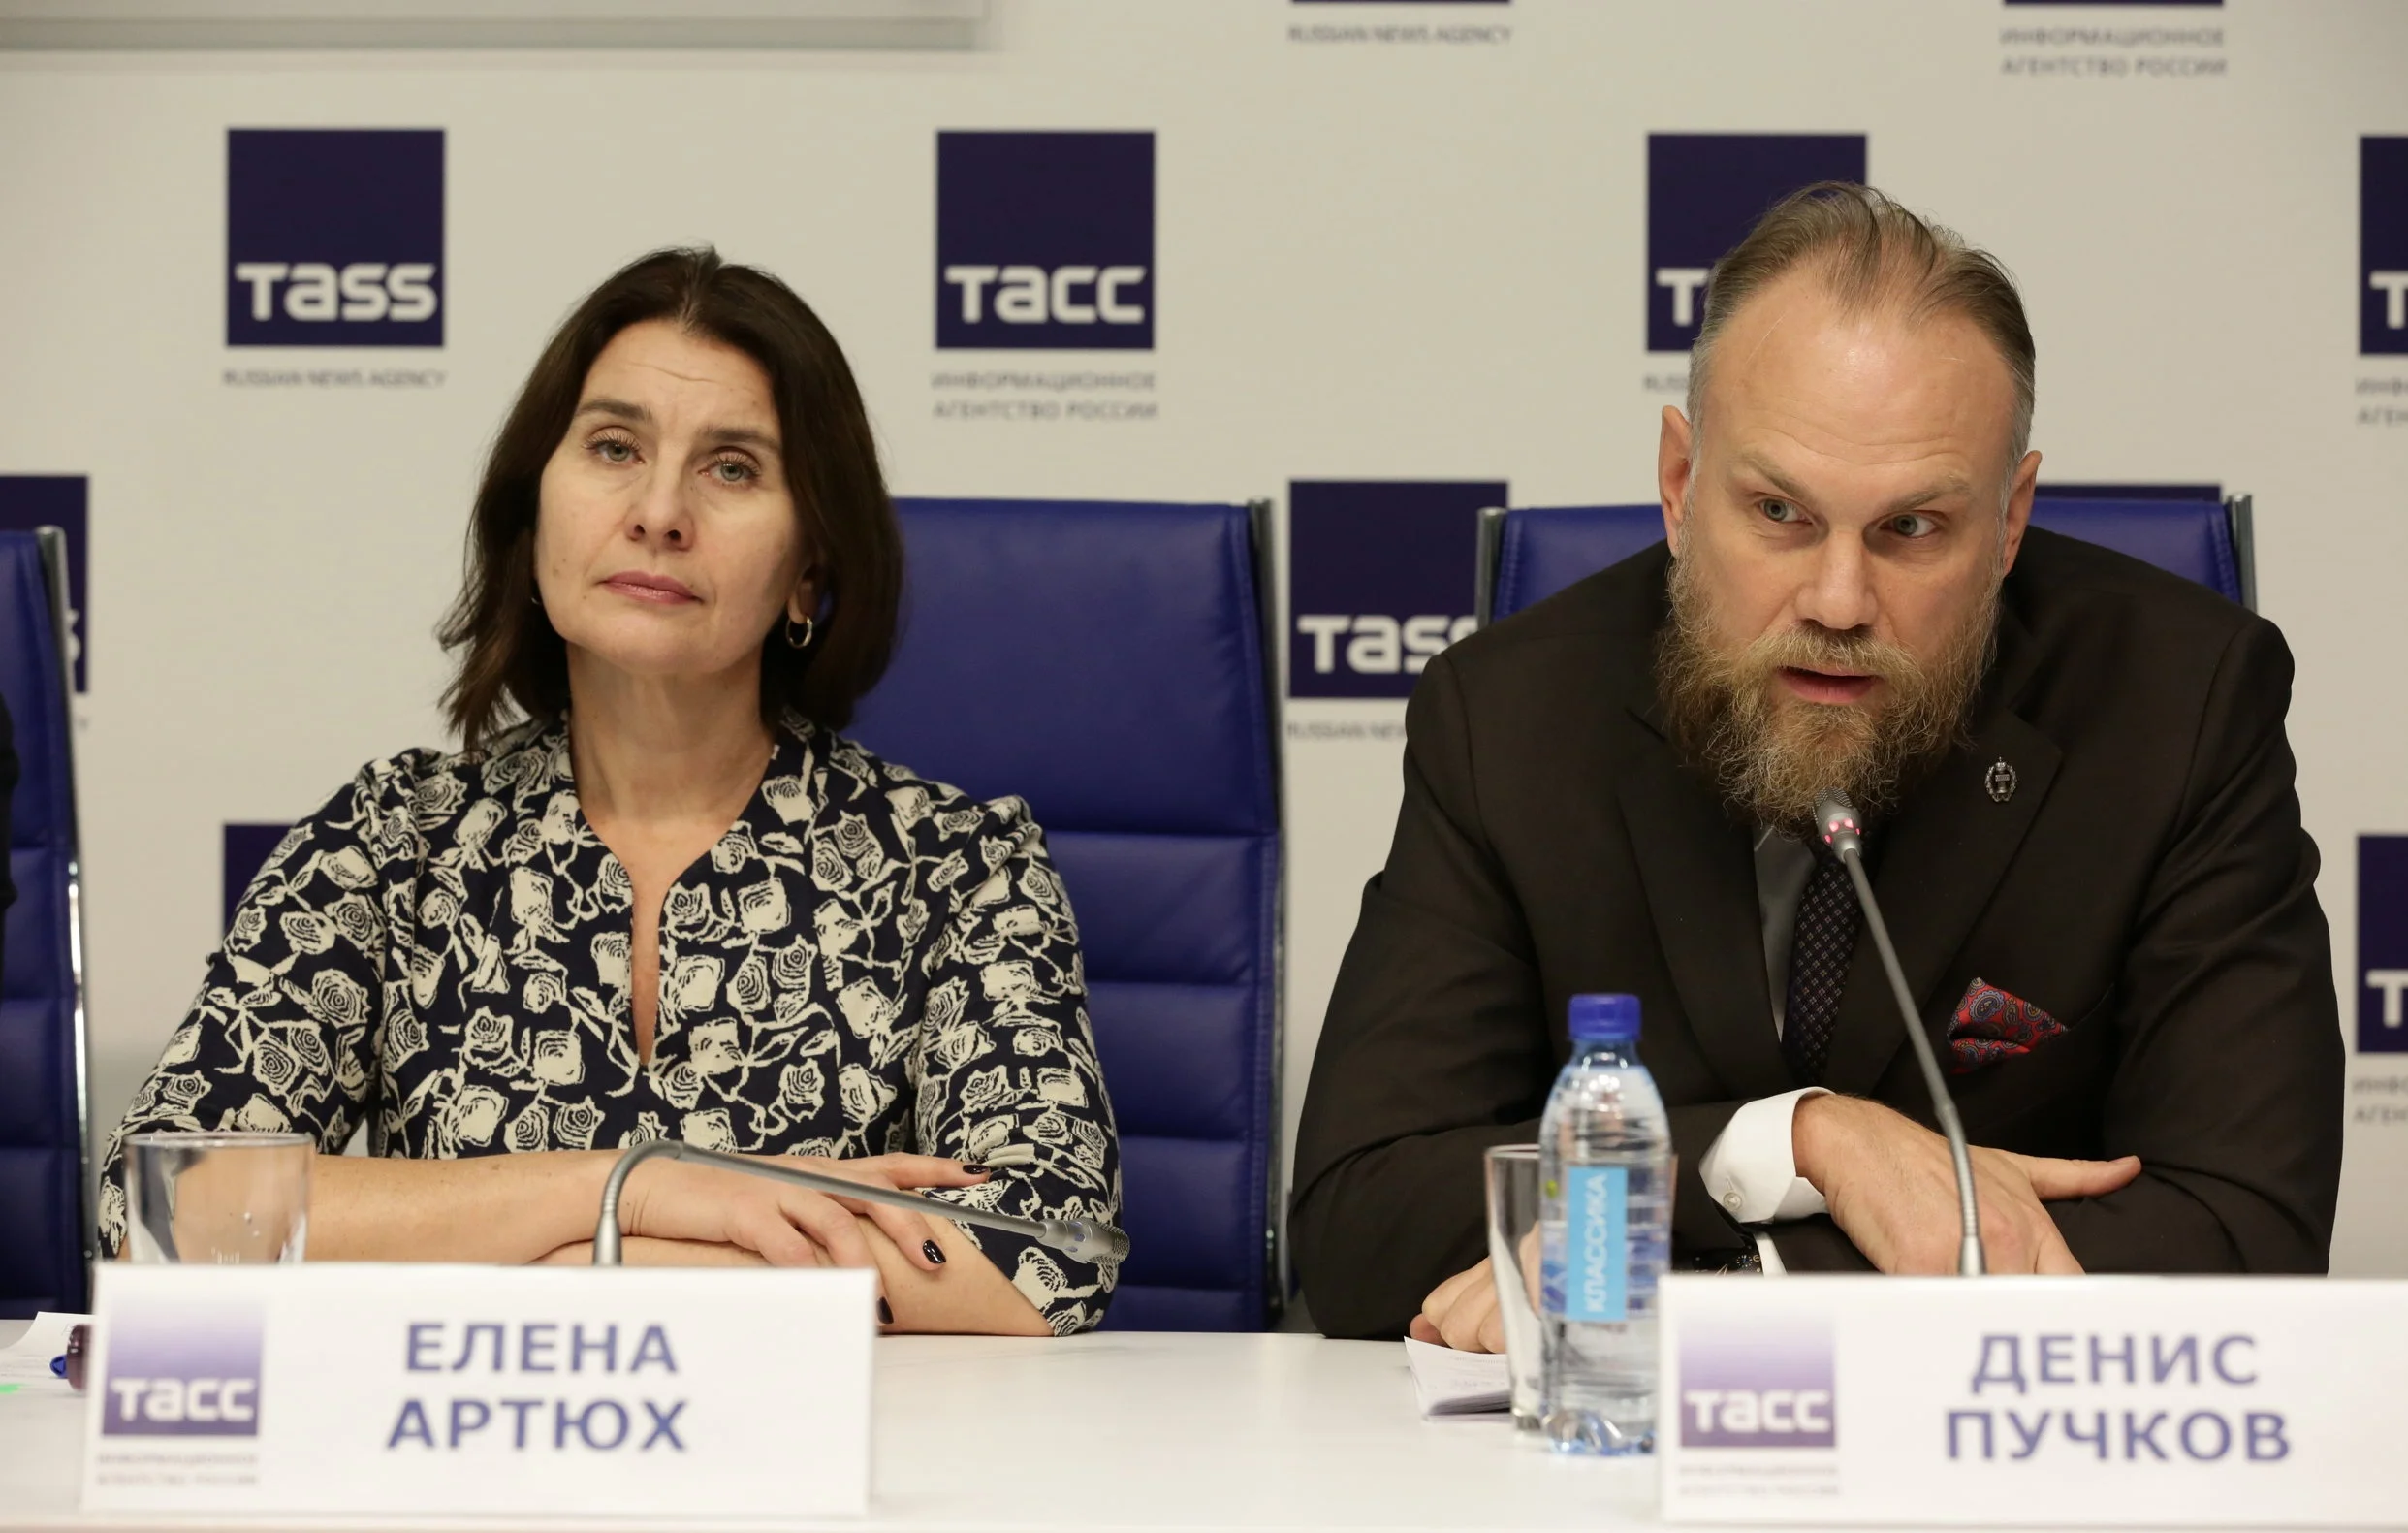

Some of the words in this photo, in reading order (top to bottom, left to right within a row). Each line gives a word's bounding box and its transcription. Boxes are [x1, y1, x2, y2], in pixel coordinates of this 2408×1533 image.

[1583, 1172, 1608, 1312] КЛАССИКА
[405, 1323, 679, 1374] ЕЛЕНА
[1971, 1333, 2259, 1396] ДЕНИС
[387, 1398, 687, 1452] АРТЮХ
[1947, 1410, 2292, 1462] ПУЧКОВ
